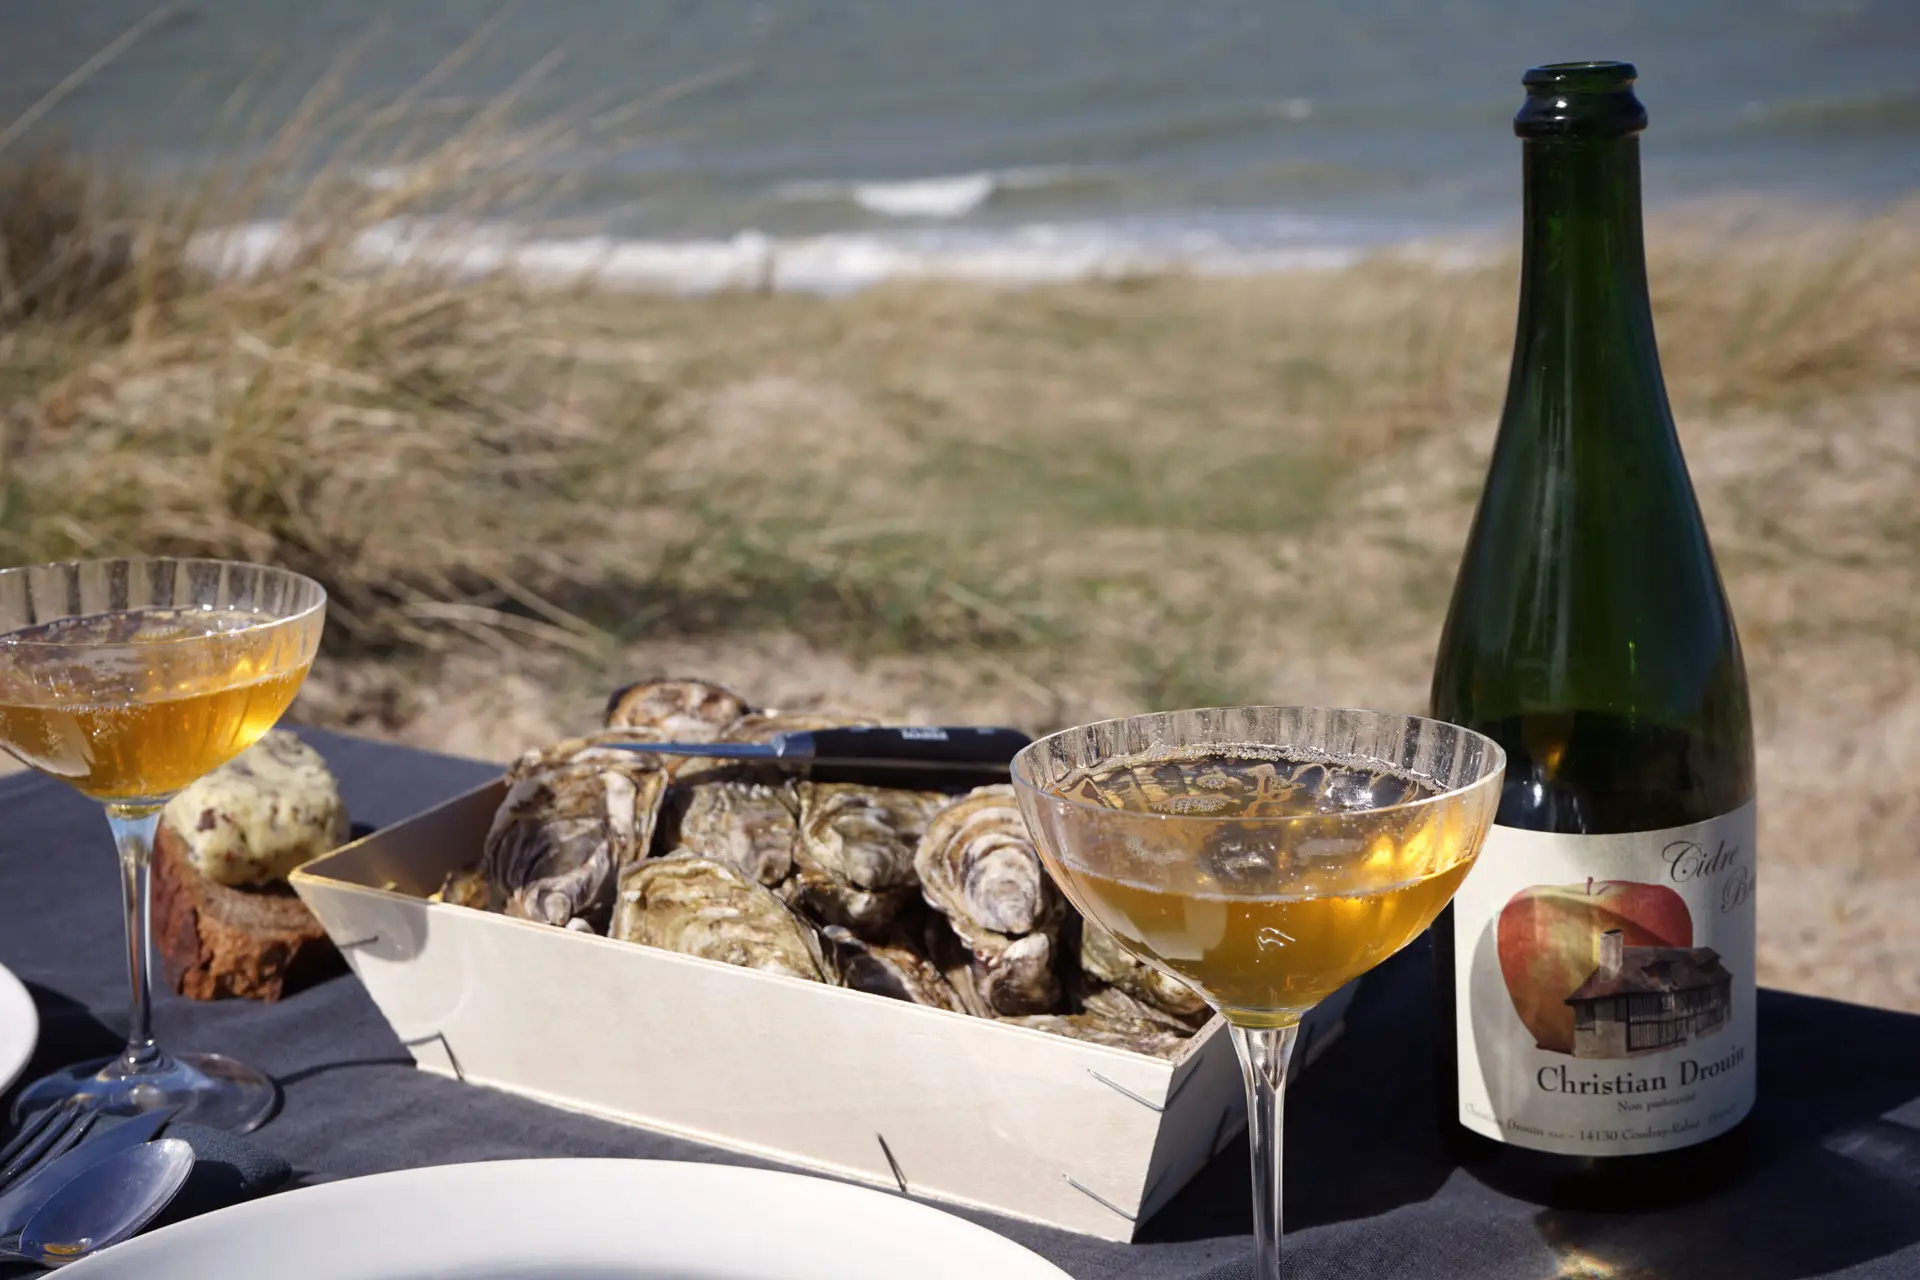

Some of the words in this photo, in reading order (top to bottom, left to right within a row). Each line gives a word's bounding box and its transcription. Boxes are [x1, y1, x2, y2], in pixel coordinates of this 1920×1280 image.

[1662, 840, 1739, 883] Cidre
[1537, 1064, 1667, 1096] Christian
[1679, 1045, 1745, 1088] Drouin
[1617, 1099, 1643, 1113] Non
[1507, 1118, 1545, 1137] Drouin
[1579, 1129, 1619, 1142] 14130
